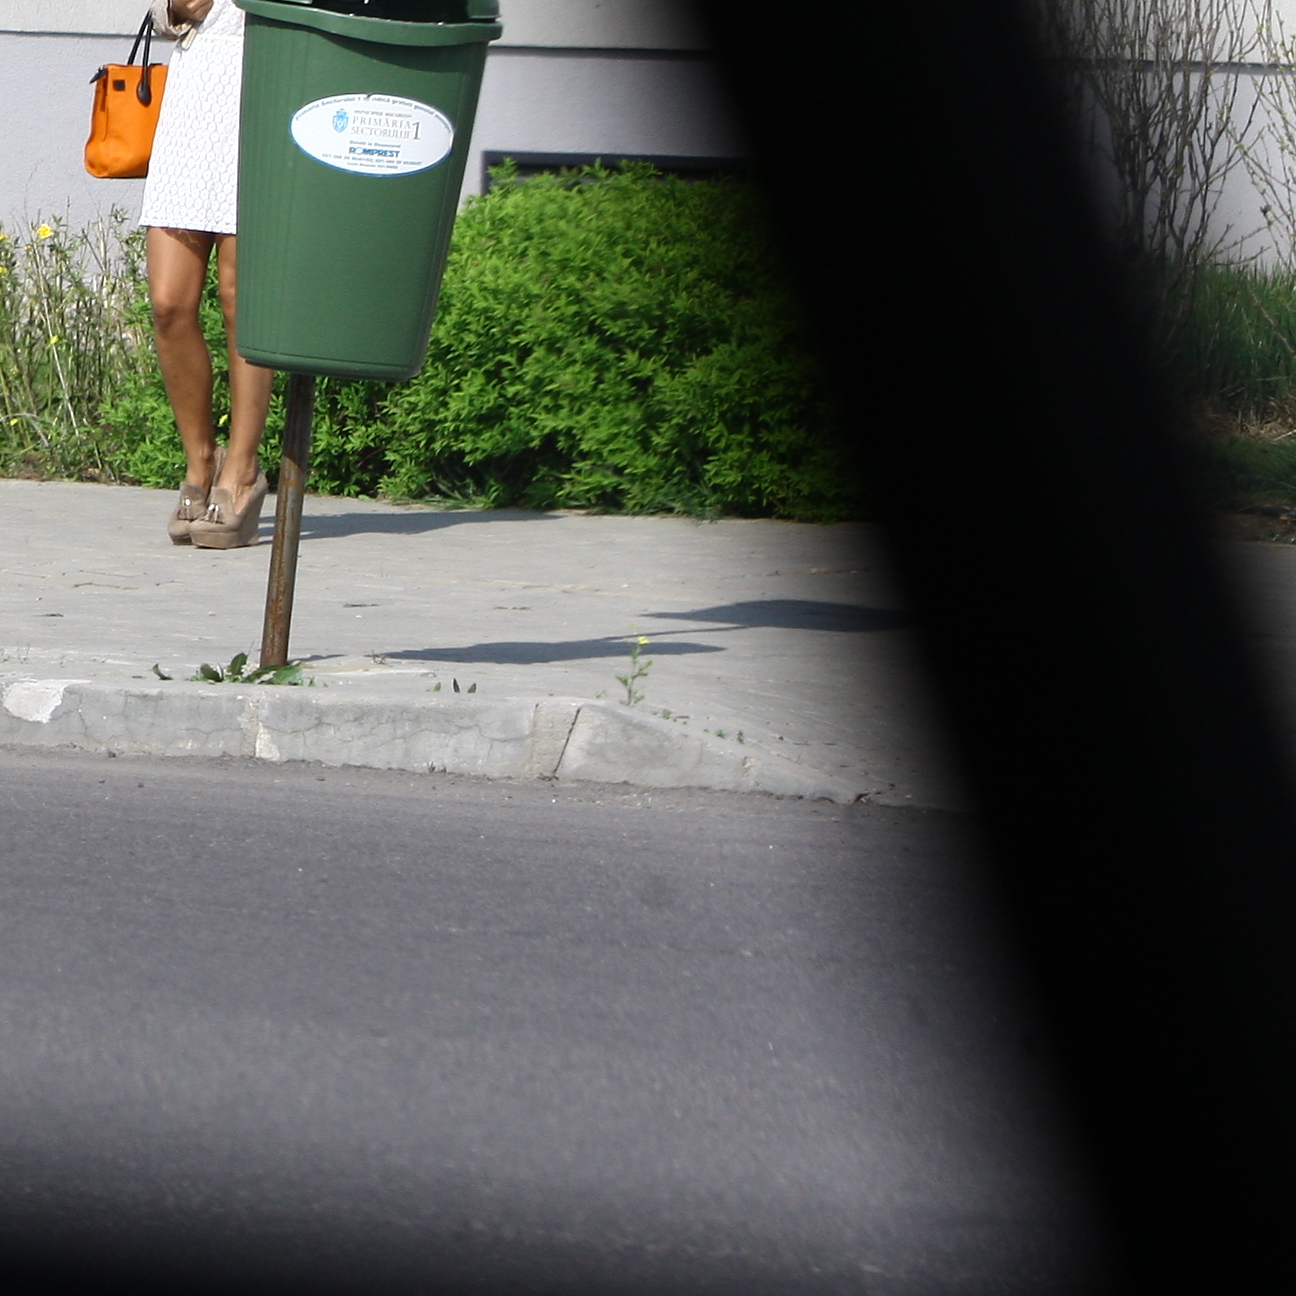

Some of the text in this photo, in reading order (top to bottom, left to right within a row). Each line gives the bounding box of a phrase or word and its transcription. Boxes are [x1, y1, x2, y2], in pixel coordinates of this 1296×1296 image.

[350, 125, 411, 139] SECTORULUI
[412, 120, 422, 141] 1
[349, 146, 400, 158] ROMPREST
